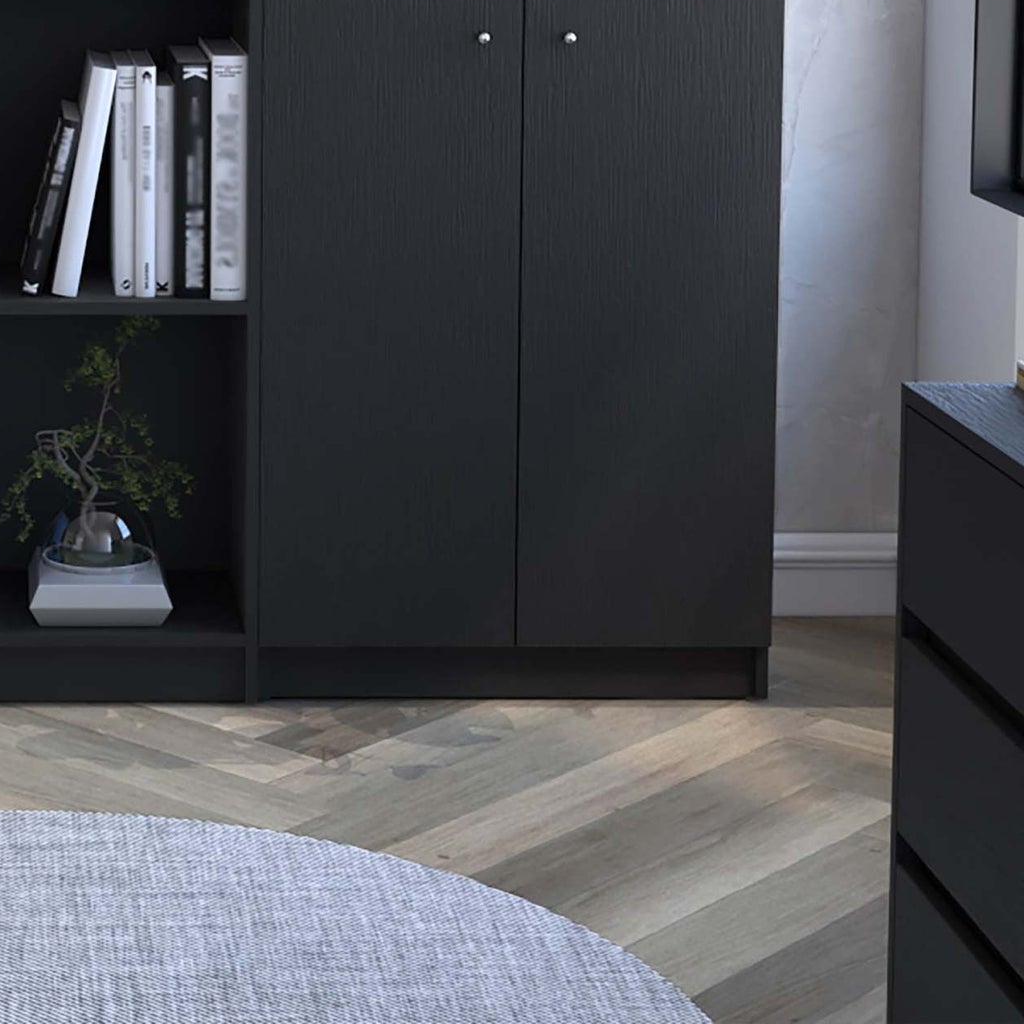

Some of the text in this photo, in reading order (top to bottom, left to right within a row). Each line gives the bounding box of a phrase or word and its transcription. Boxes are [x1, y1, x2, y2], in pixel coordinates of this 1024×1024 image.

[182, 64, 208, 80] K
[22, 279, 39, 294] K
[156, 281, 169, 292] K
